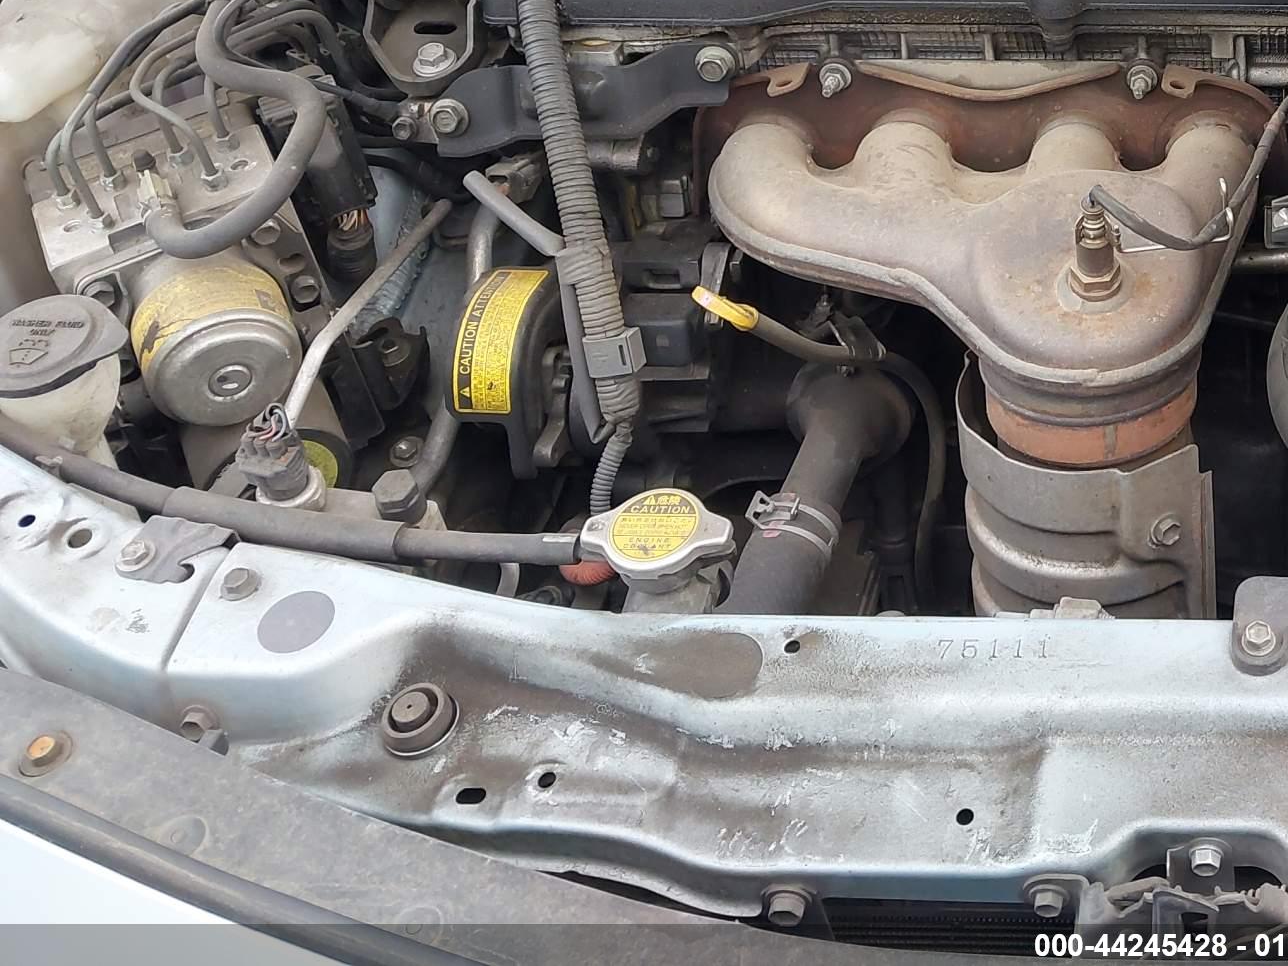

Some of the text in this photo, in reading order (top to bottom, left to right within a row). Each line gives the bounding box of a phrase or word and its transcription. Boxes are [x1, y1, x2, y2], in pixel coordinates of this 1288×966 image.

[459, 321, 478, 375] CAUTION
[473, 275, 506, 317] ATTENTION
[630, 505, 690, 514] CAUTION
